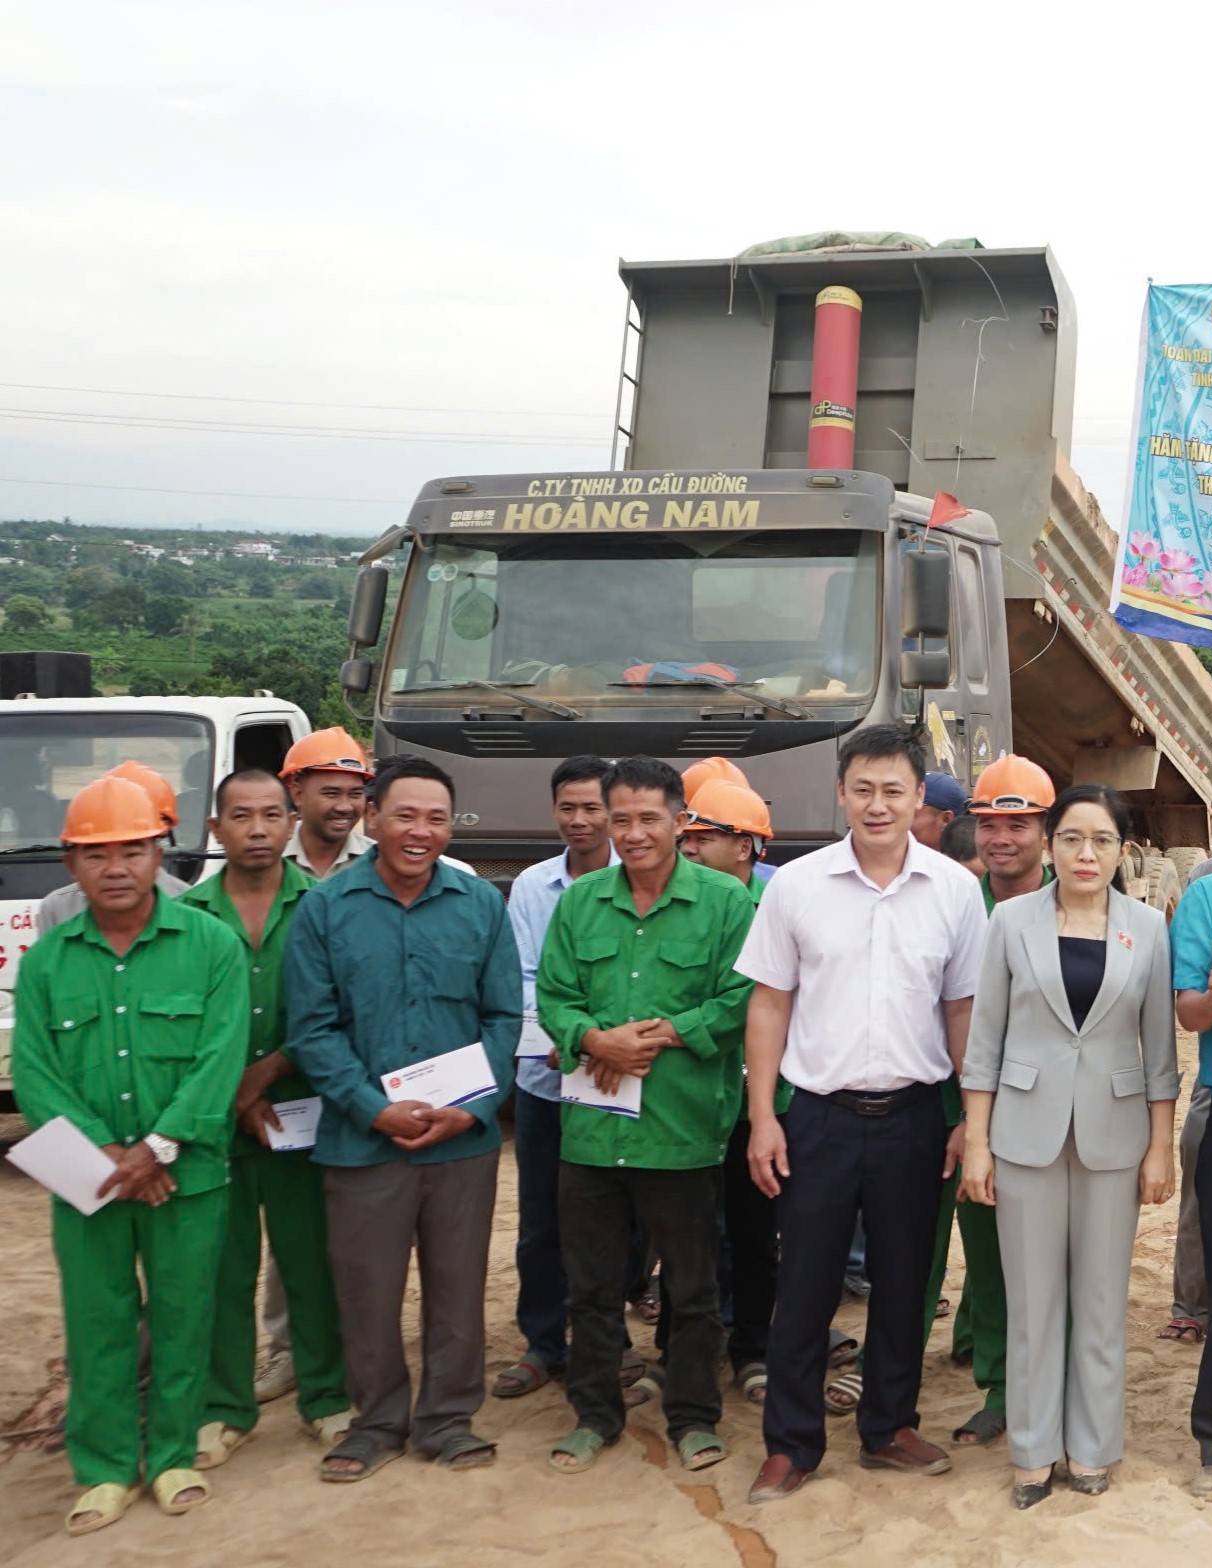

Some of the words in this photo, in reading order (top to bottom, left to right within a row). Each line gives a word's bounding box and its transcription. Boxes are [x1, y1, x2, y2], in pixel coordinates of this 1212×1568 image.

[571, 477, 617, 496] TNHH
[619, 477, 643, 495] XD
[504, 496, 650, 530] HOÀNG
[662, 500, 760, 528] NAM
[449, 520, 493, 528] SINOTRUK
